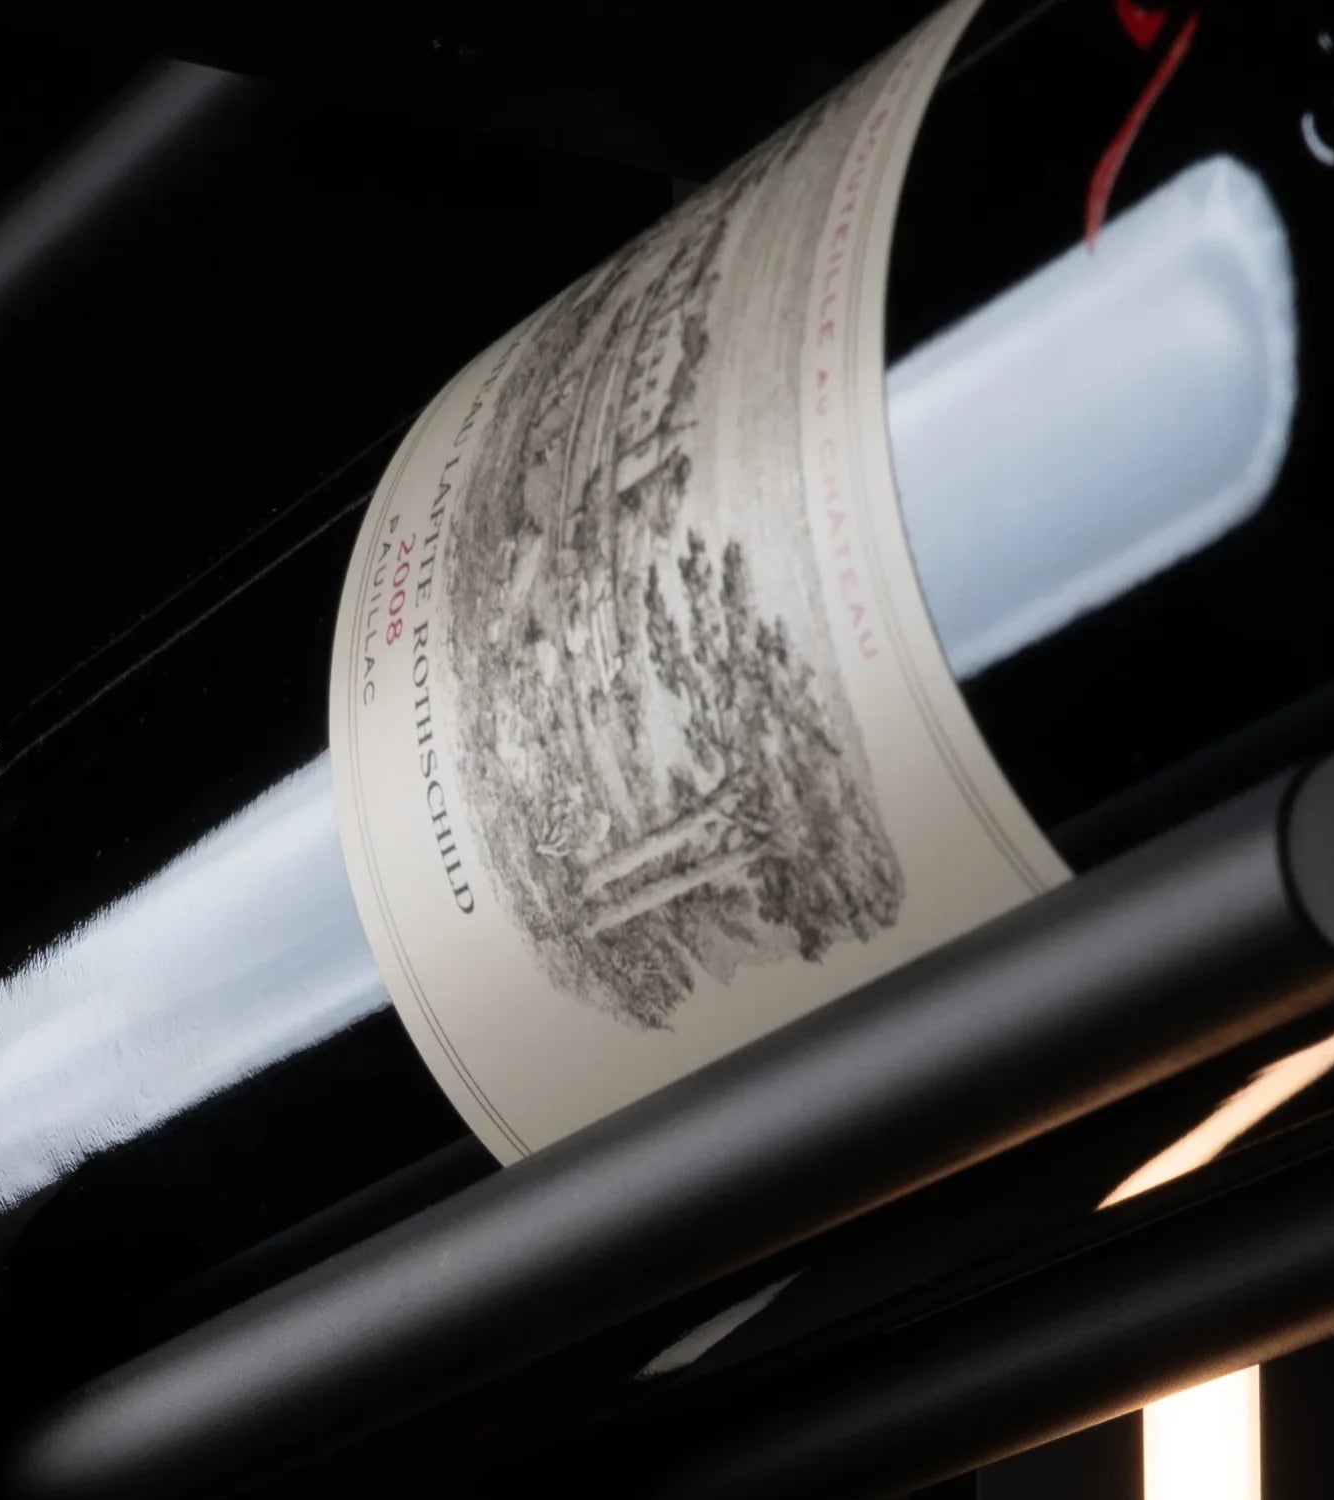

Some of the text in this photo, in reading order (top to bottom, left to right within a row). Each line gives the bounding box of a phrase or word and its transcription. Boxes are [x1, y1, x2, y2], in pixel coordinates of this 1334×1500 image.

[363, 514, 400, 706] PAUILLAC
[385, 533, 416, 646] 2008
[416, 456, 460, 608] LAFITE
[413, 620, 475, 916] ROTHSCHILD
